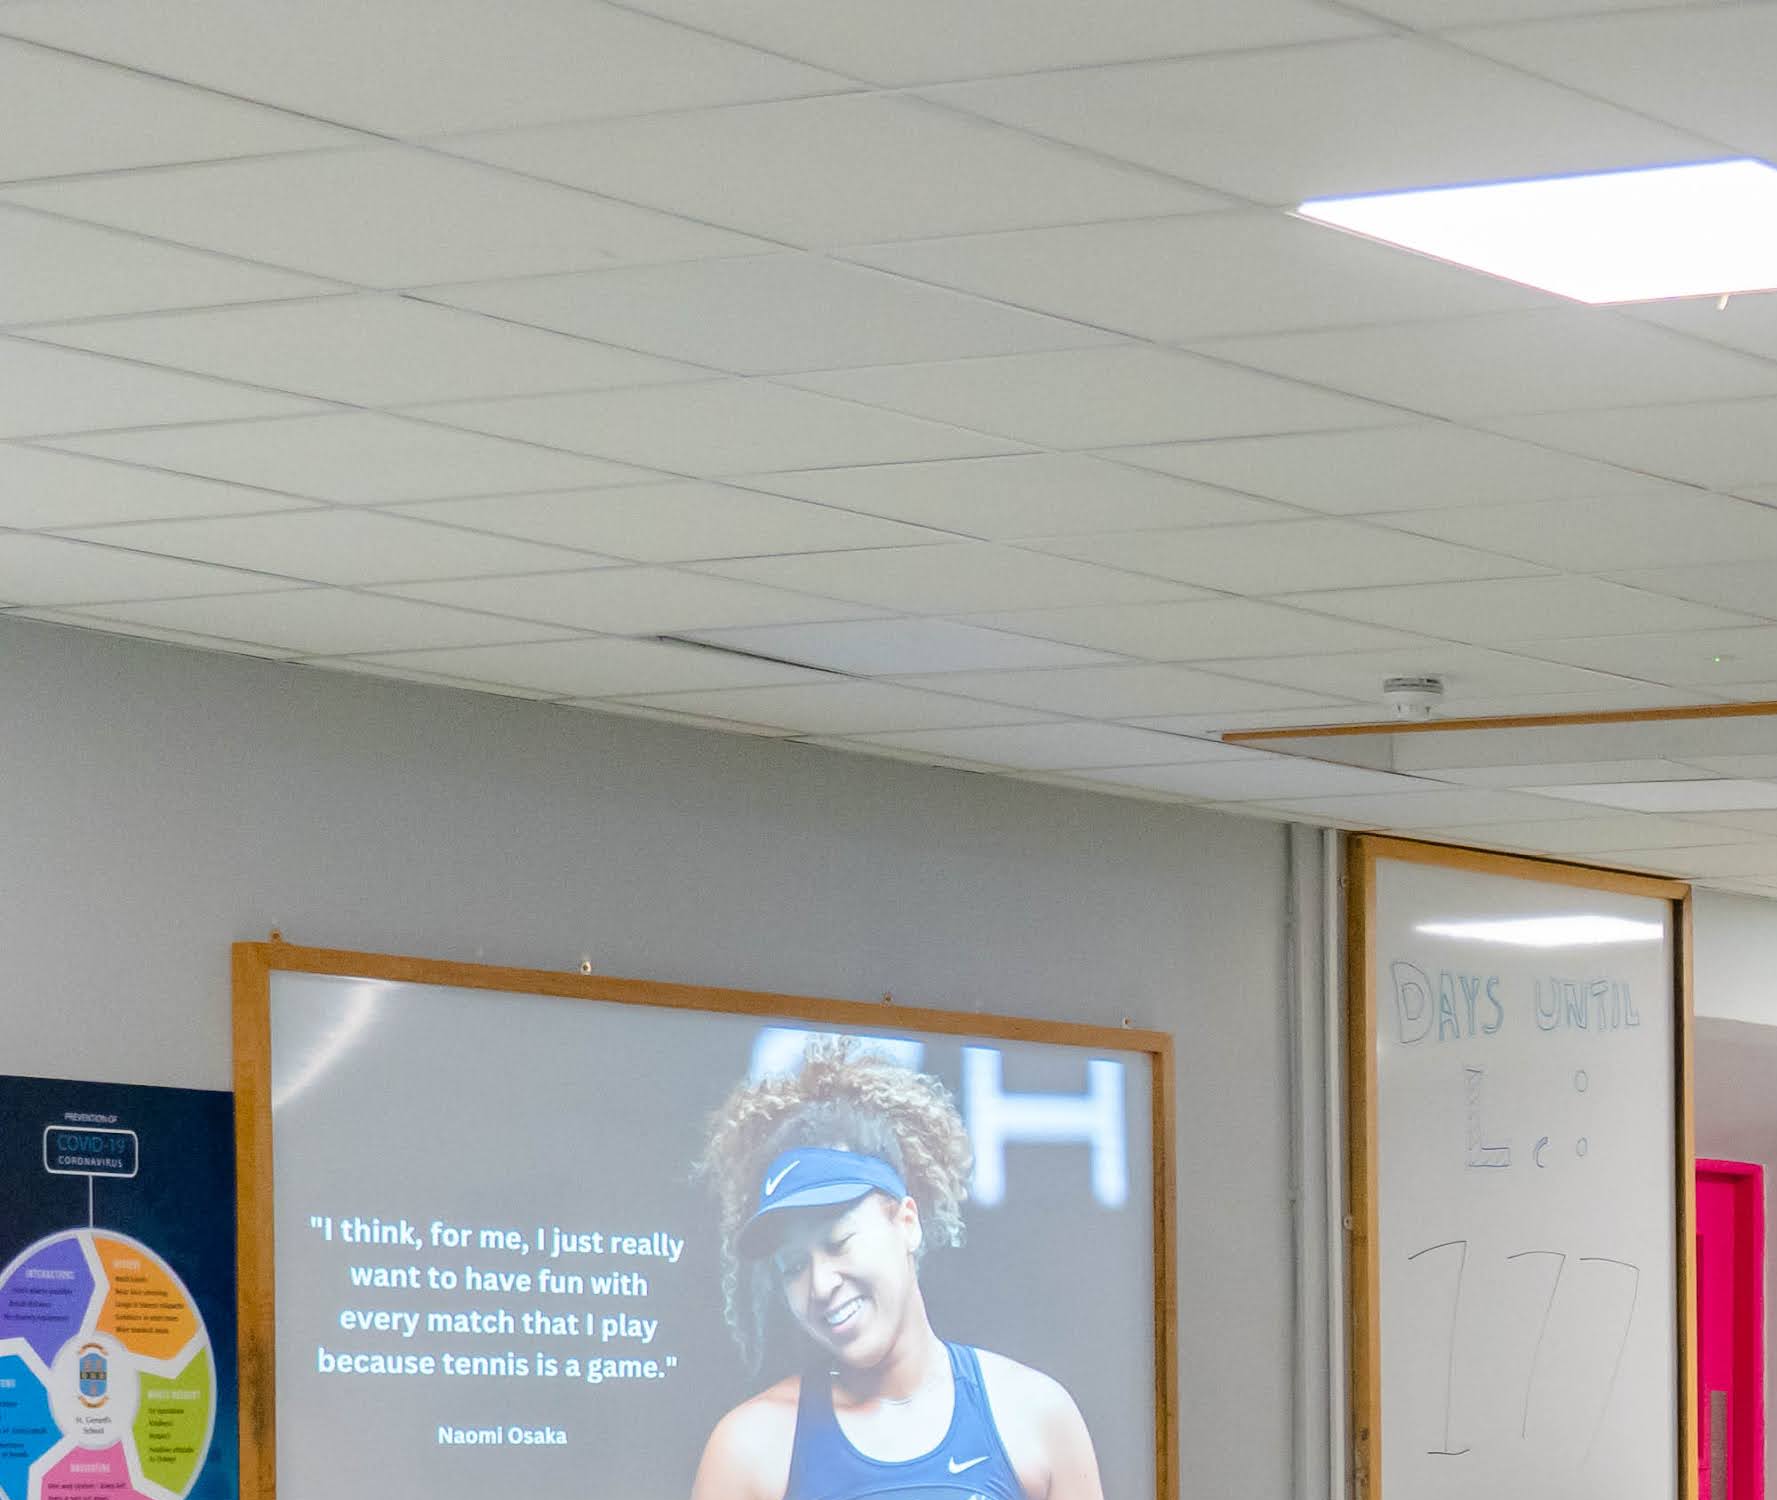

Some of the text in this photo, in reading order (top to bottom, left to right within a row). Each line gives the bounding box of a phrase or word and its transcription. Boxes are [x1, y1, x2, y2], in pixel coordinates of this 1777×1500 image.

[1391, 960, 1641, 1043] DAYS UNTIL
[56, 1133, 127, 1154] COVID-19
[58, 1155, 124, 1168] CORONAVIRUS
[341, 1218, 423, 1250] think,
[430, 1221, 473, 1248] for
[479, 1226, 530, 1255] me,
[537, 1228, 545, 1250] I
[550, 1227, 604, 1257] just
[610, 1231, 685, 1263] really
[350, 1265, 649, 1297] want to have fun with
[339, 1309, 658, 1344] every match that I play
[317, 1346, 679, 1384] because tennis is a game."
[438, 1426, 568, 1446] Naomi Osaka
